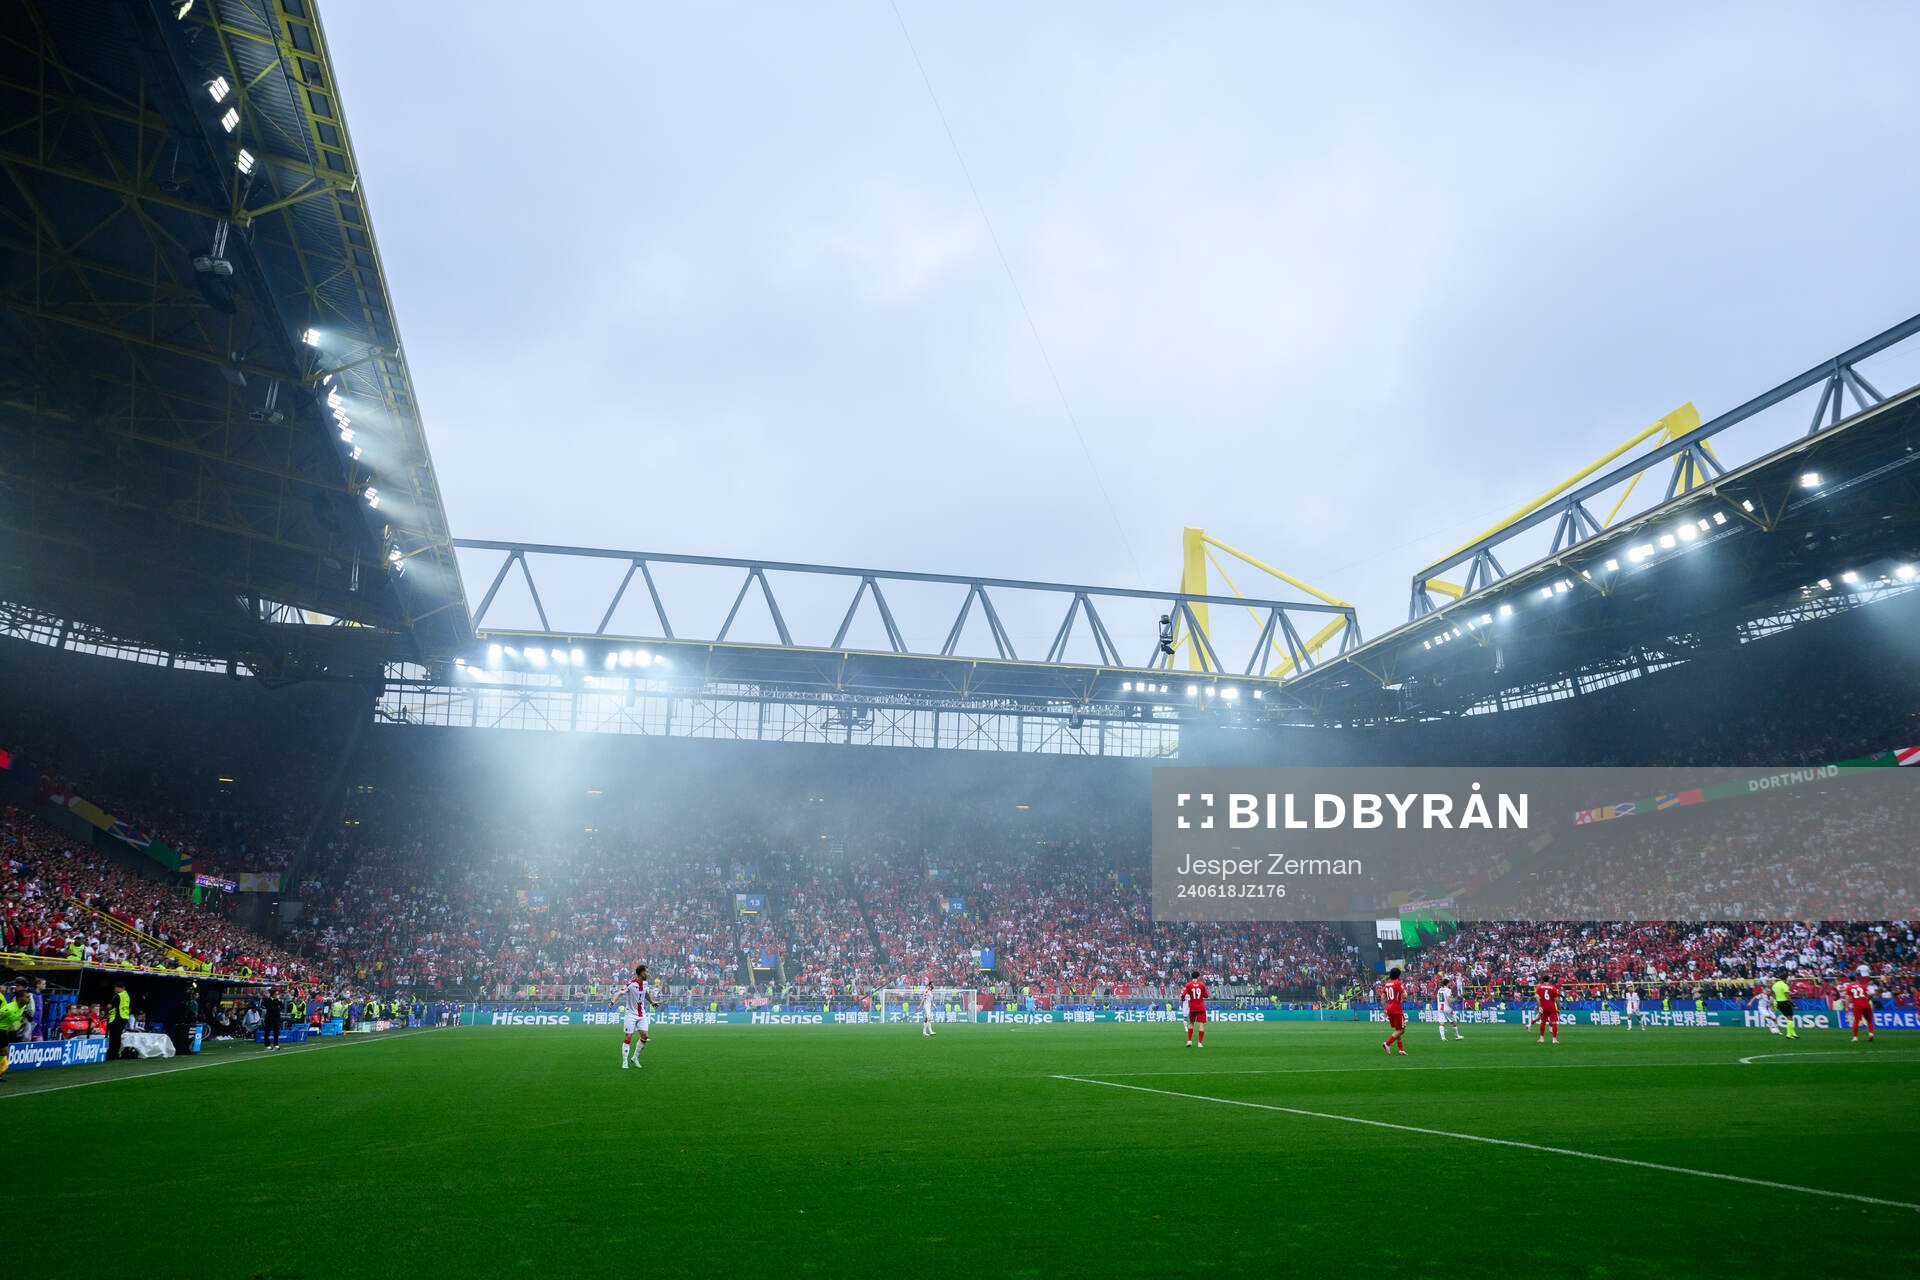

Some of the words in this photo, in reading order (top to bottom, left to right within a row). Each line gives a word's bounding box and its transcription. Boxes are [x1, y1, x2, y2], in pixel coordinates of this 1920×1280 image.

[1748, 765, 1839, 791] DORTMUND
[1190, 988, 1201, 999] 19
[1544, 989, 1550, 1001] 6
[1850, 988, 1866, 999] 22
[491, 1012, 570, 1025] Hisense
[751, 1011, 823, 1024] Hisense
[987, 1011, 1053, 1023] Hisense
[1206, 1010, 1265, 1022] Hisense
[1369, 1010, 1409, 1022] Hise
[1521, 1010, 1576, 1025] Hise
[1744, 1010, 1830, 1028] Hiense
[8, 1044, 62, 1067] Booking.com
